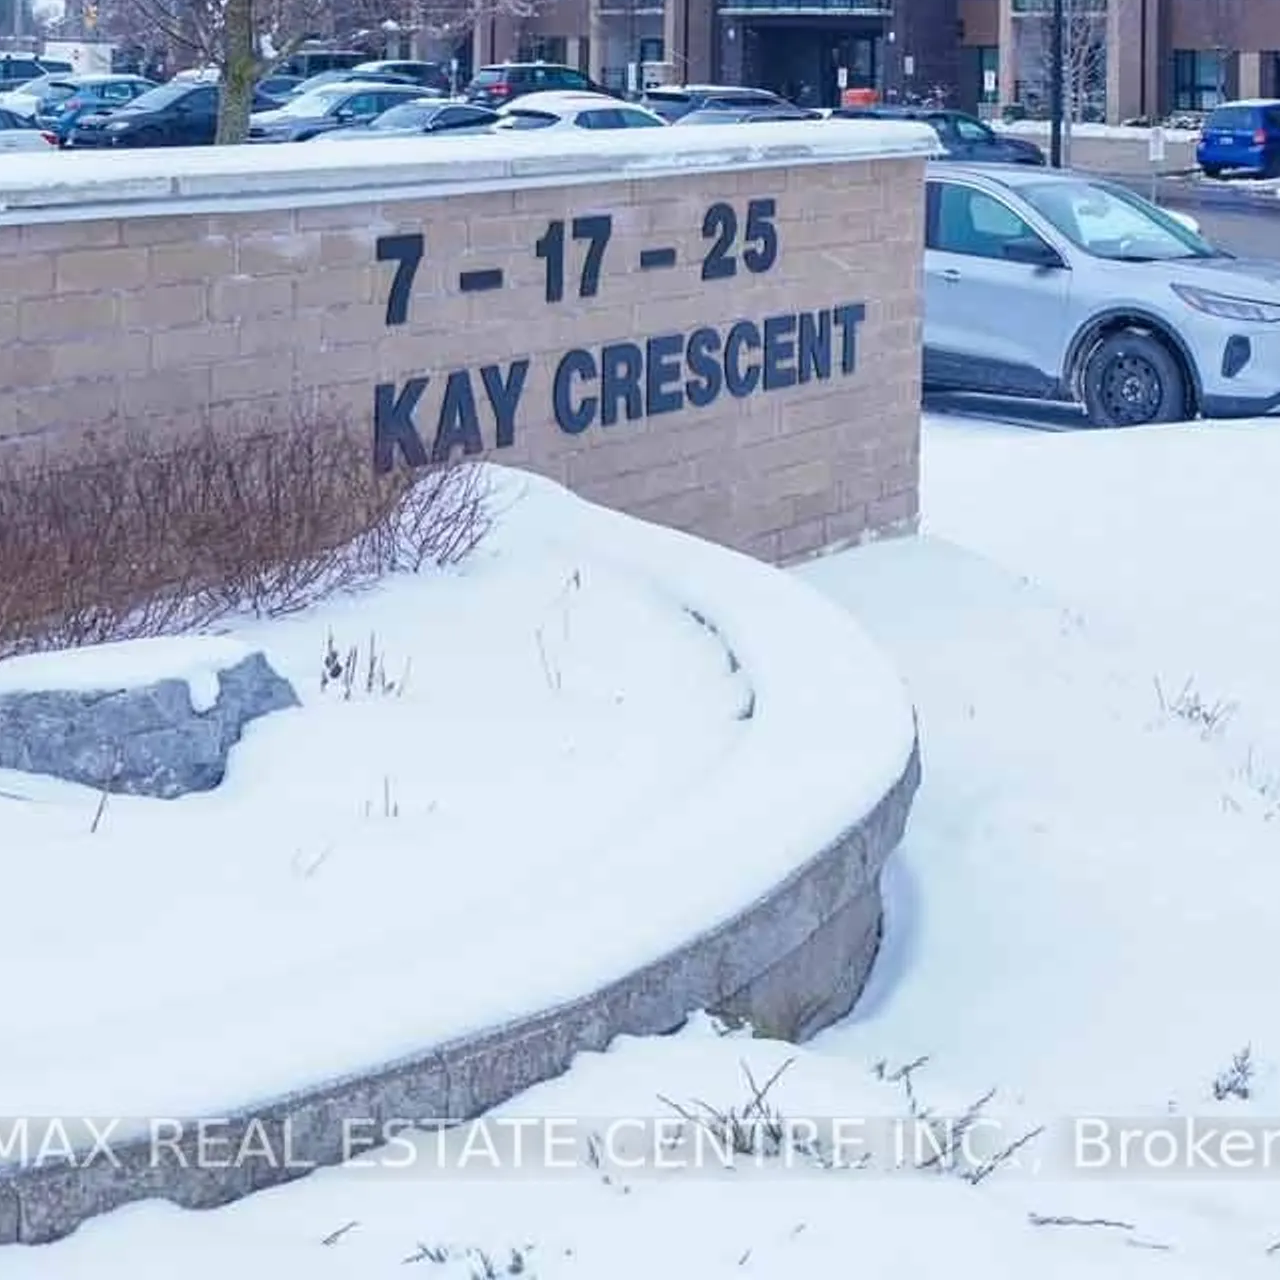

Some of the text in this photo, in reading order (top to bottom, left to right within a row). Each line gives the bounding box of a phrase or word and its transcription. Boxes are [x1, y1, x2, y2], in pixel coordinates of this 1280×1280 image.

[376, 233, 425, 326] 7
[536, 215, 613, 304] 17
[701, 197, 779, 282] 25
[373, 303, 866, 474] KAY CRESCENT
